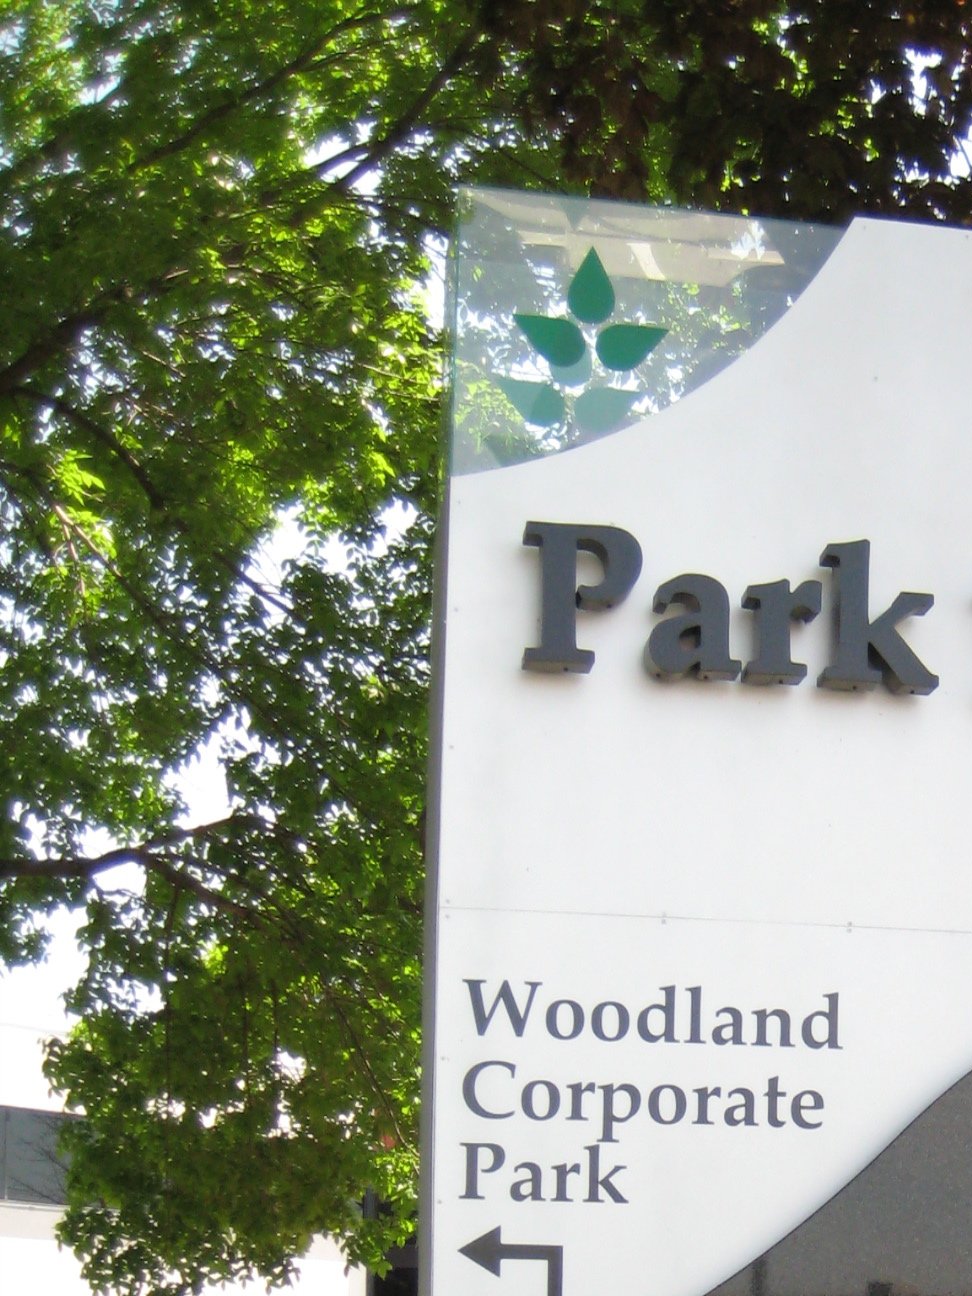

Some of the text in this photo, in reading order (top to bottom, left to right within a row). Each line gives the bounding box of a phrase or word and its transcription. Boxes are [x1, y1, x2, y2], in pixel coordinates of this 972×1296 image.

[522, 520, 940, 697] Park
[462, 978, 844, 1050] Woodland
[462, 1060, 825, 1143] Corporate
[458, 1142, 630, 1204] Park
